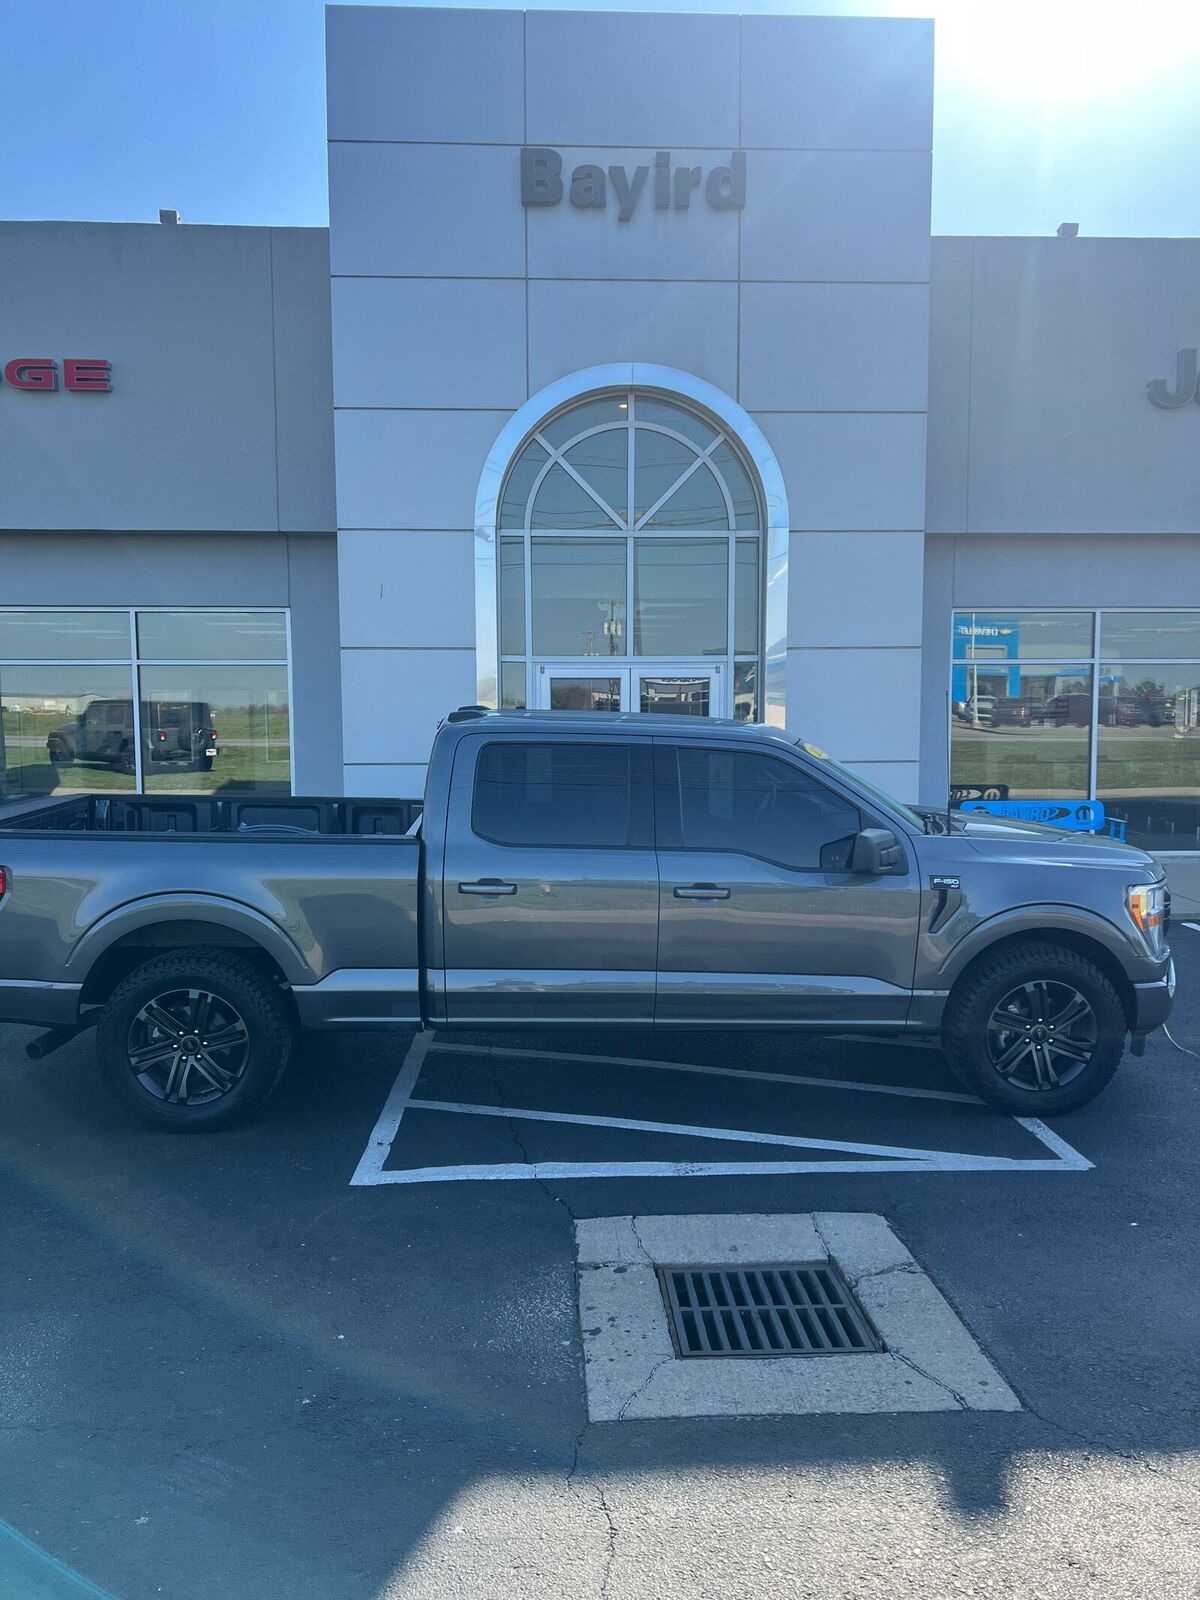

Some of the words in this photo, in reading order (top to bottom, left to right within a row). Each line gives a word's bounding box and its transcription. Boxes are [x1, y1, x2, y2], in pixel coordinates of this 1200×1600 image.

[520, 148, 747, 222] Bayird
[0, 358, 112, 392] GE
[1146, 348, 1200, 409] J
